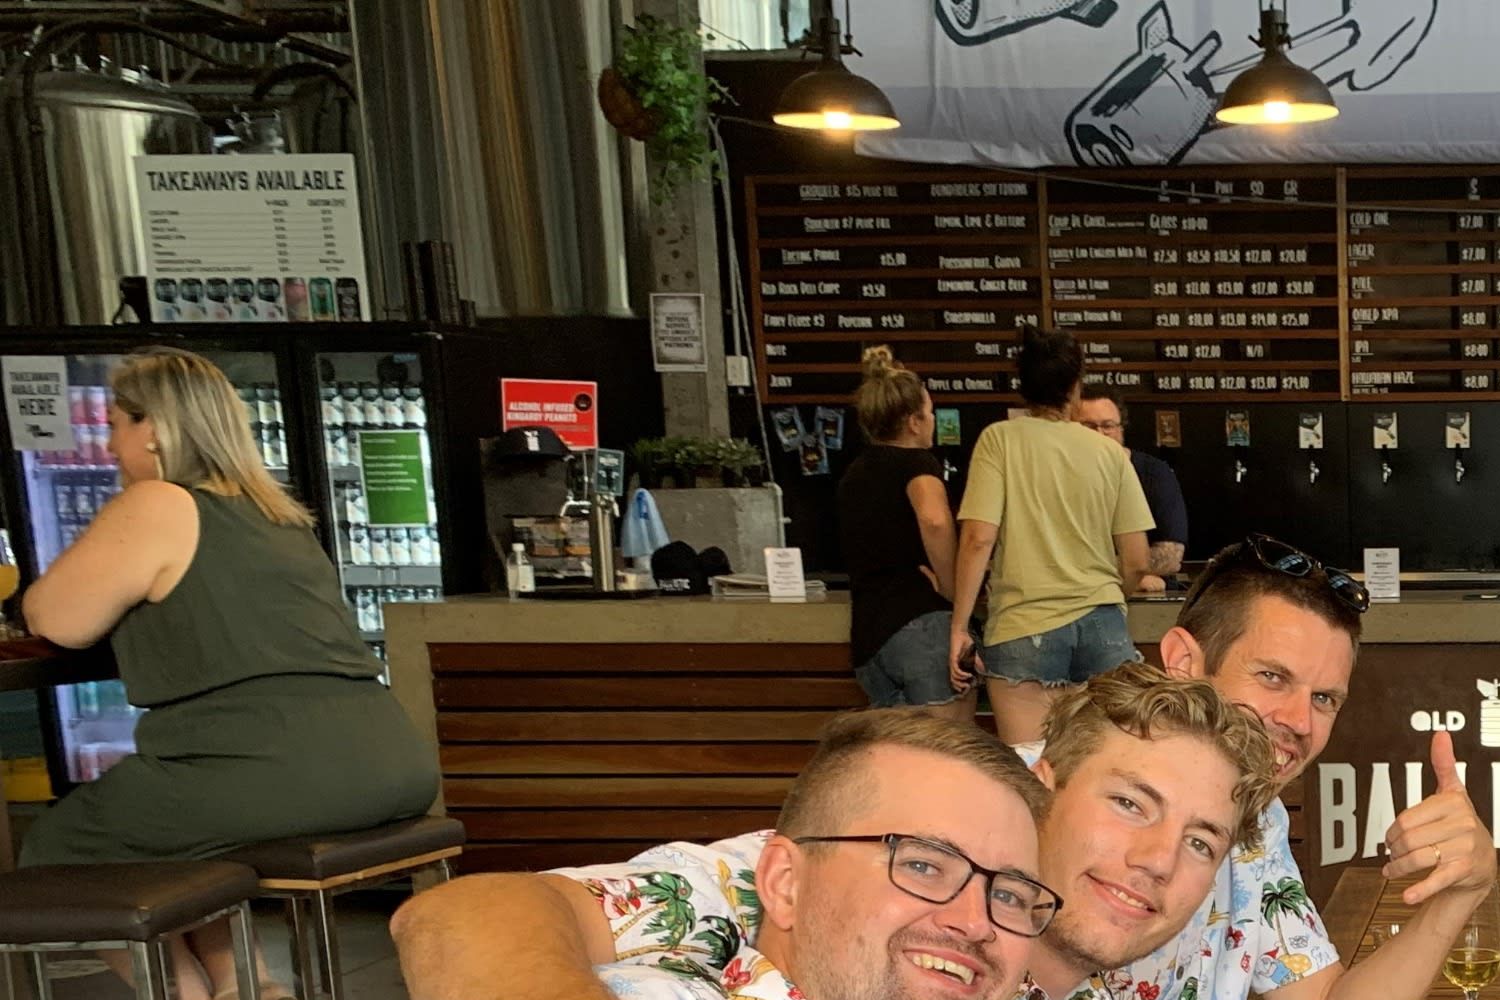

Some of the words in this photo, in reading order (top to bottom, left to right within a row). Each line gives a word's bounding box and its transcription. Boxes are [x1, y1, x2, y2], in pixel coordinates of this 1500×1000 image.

[147, 170, 249, 191] TAKEAWAYS
[255, 169, 347, 190] AVAILABLE
[1460, 214, 1484, 228] $7.00
[1154, 250, 1178, 263] $7.50
[1462, 247, 1486, 261] $7.00
[1461, 279, 1485, 293] $7.00
[18, 398, 57, 416] HERE
[1410, 710, 1466, 732] QLD
